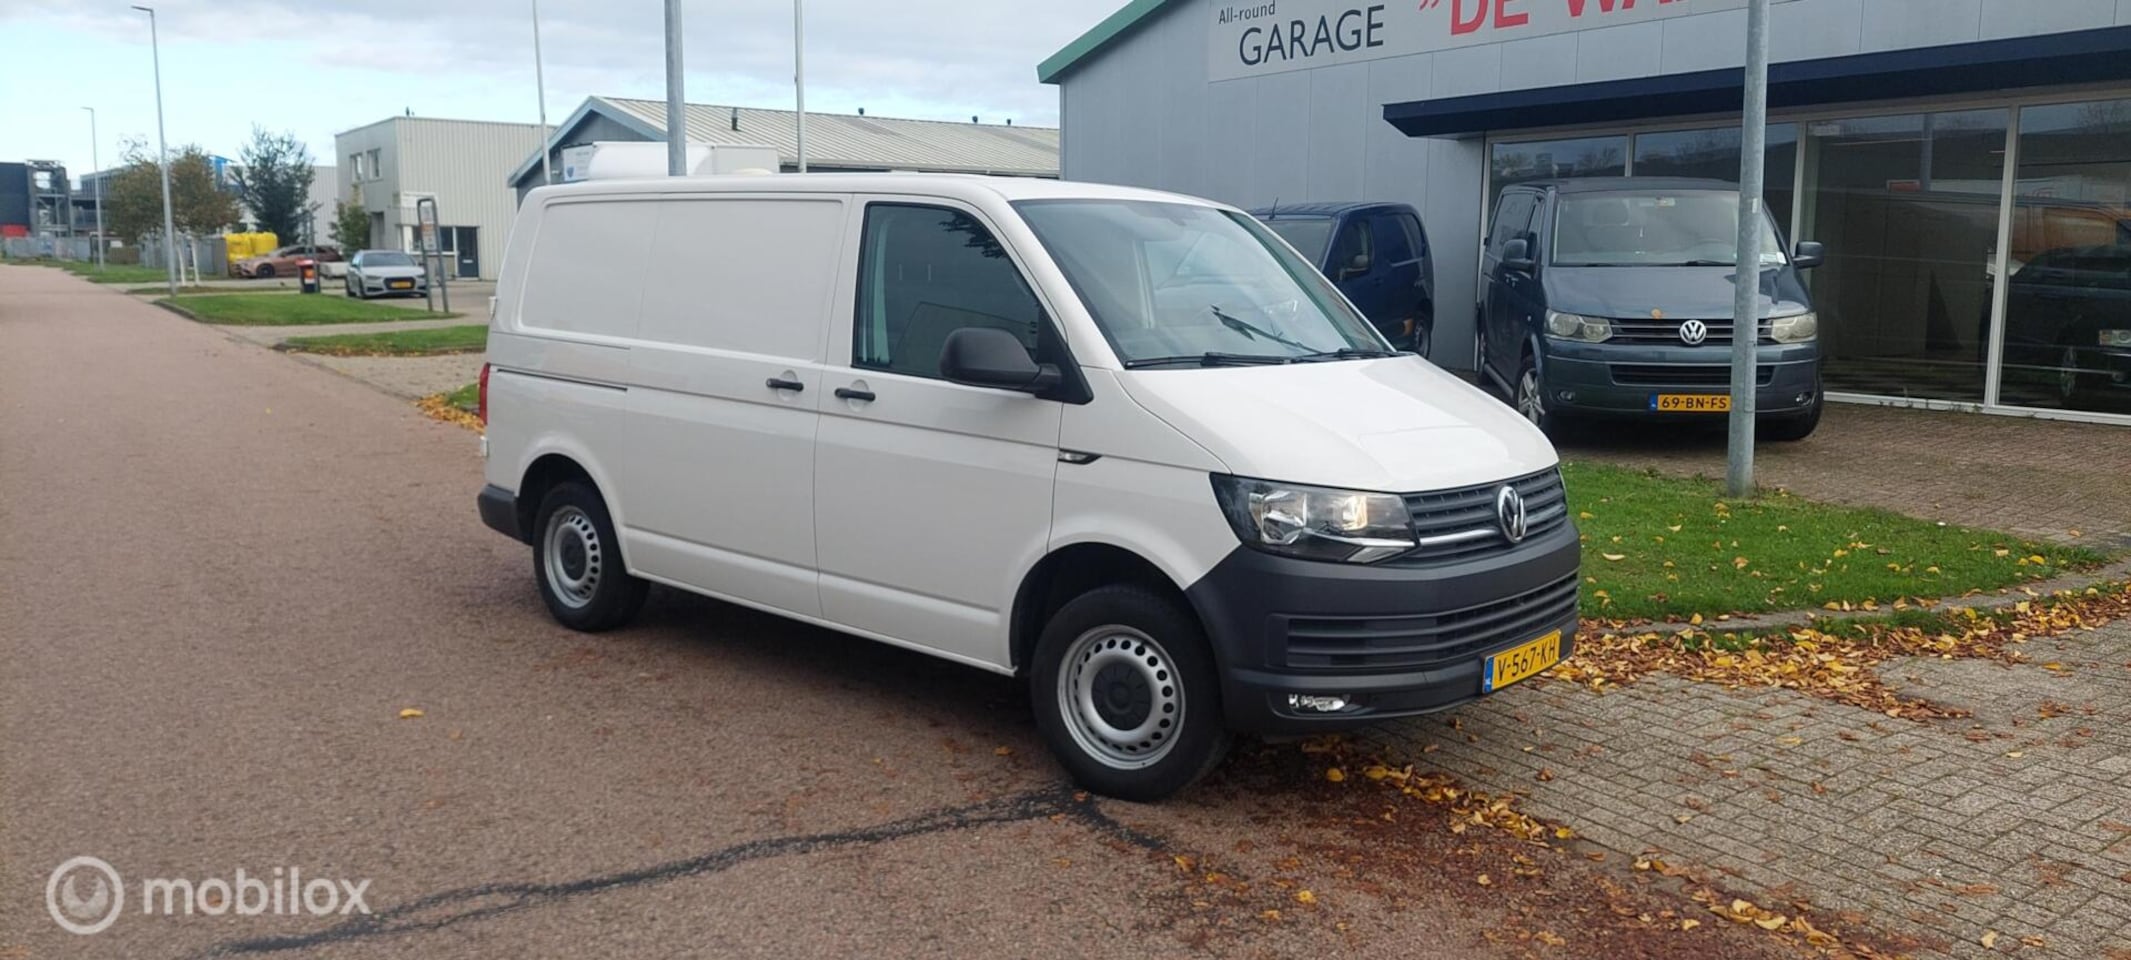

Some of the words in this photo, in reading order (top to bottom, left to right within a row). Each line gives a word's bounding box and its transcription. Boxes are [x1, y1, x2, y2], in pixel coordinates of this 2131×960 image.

[1218, 0, 1276, 25] All-round
[1239, 5, 1385, 66] GARAGE
[1661, 396, 1728, 409] 69-BN-FS
[1497, 637, 1557, 682] V-567-KH
